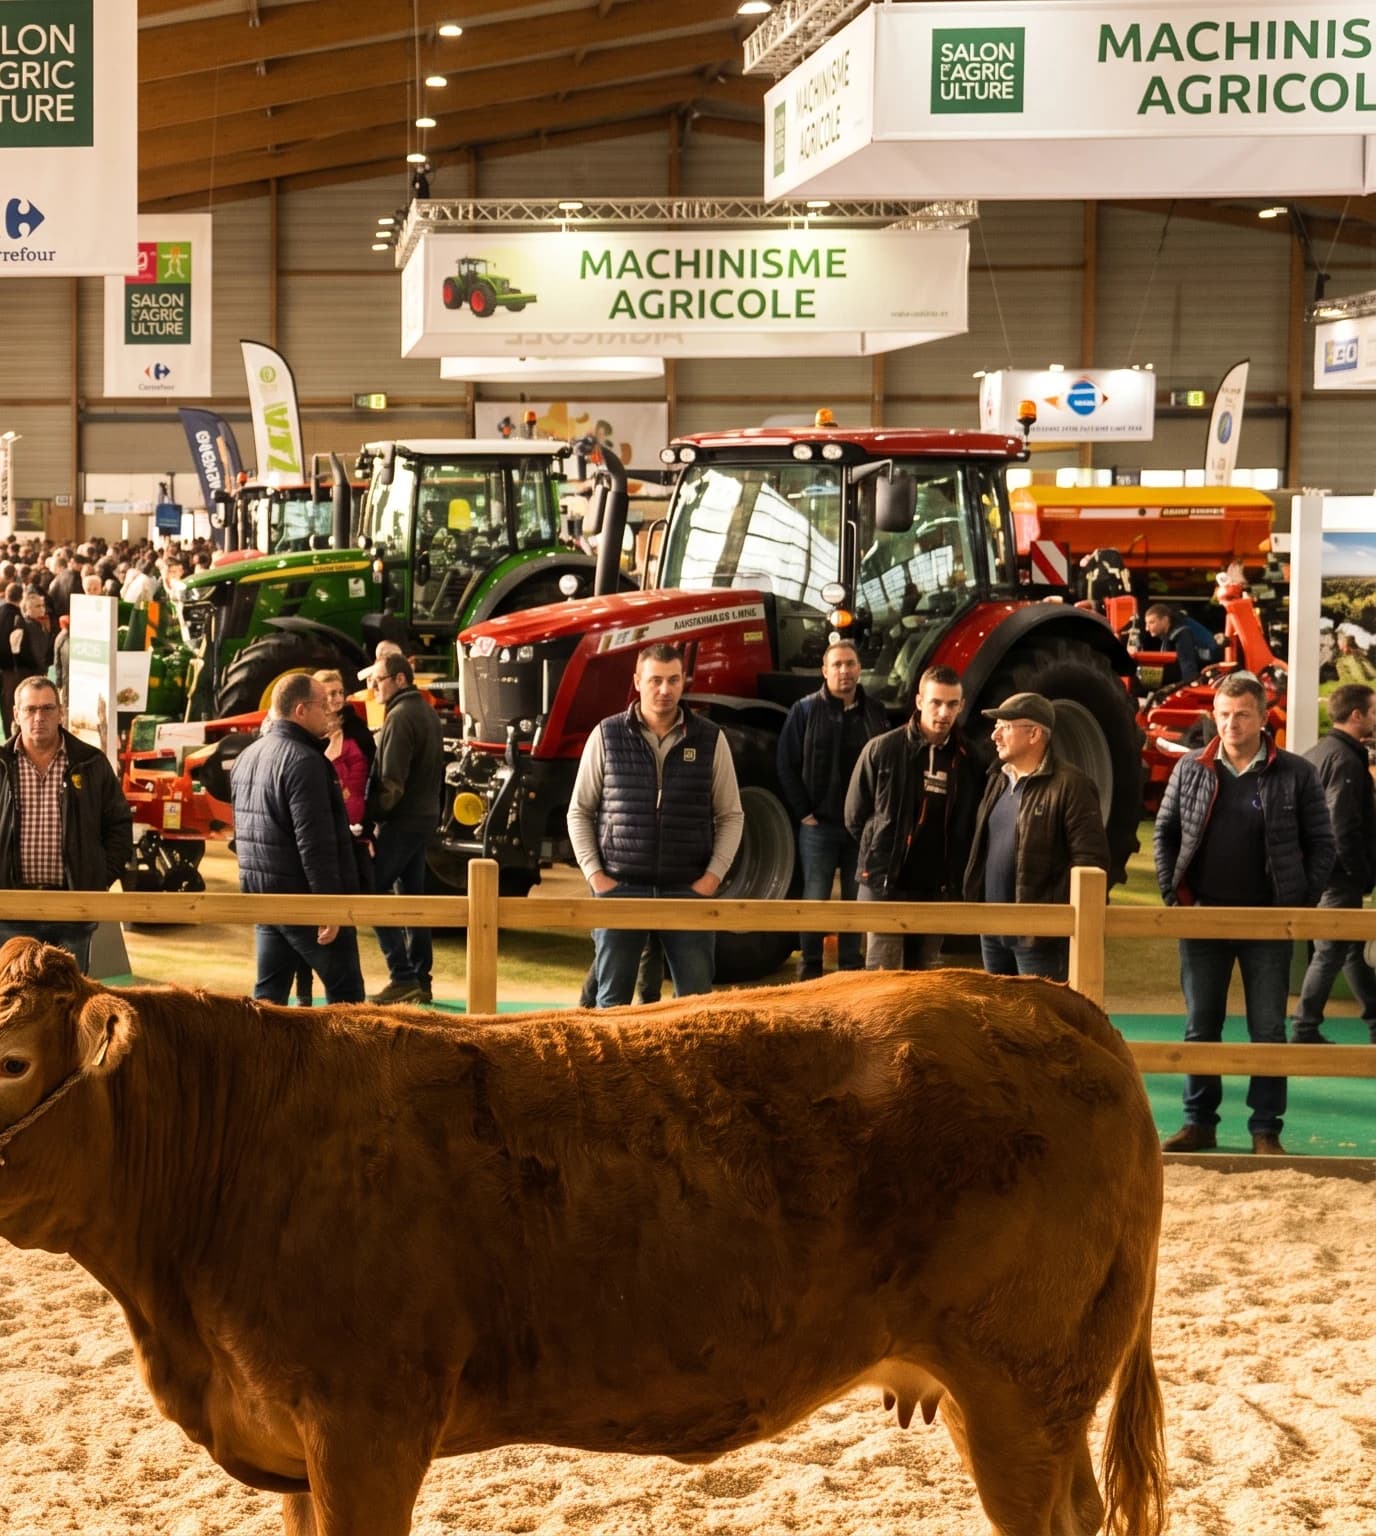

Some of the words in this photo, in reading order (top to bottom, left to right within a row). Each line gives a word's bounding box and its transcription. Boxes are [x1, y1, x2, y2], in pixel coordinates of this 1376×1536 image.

[1097, 18, 1372, 63] MACHINIS
[940, 41, 1015, 62] SALON
[950, 62, 1015, 81] AGRIC
[940, 81, 1015, 100] ULTURE
[1136, 72, 1376, 115] AGRICOL
[579, 248, 848, 280] MACHINISME
[131, 292, 184, 308] SALON
[608, 289, 817, 320] AGRICOLE
[139, 308, 184, 321] AGRIC
[131, 321, 184, 335] ULTURE
